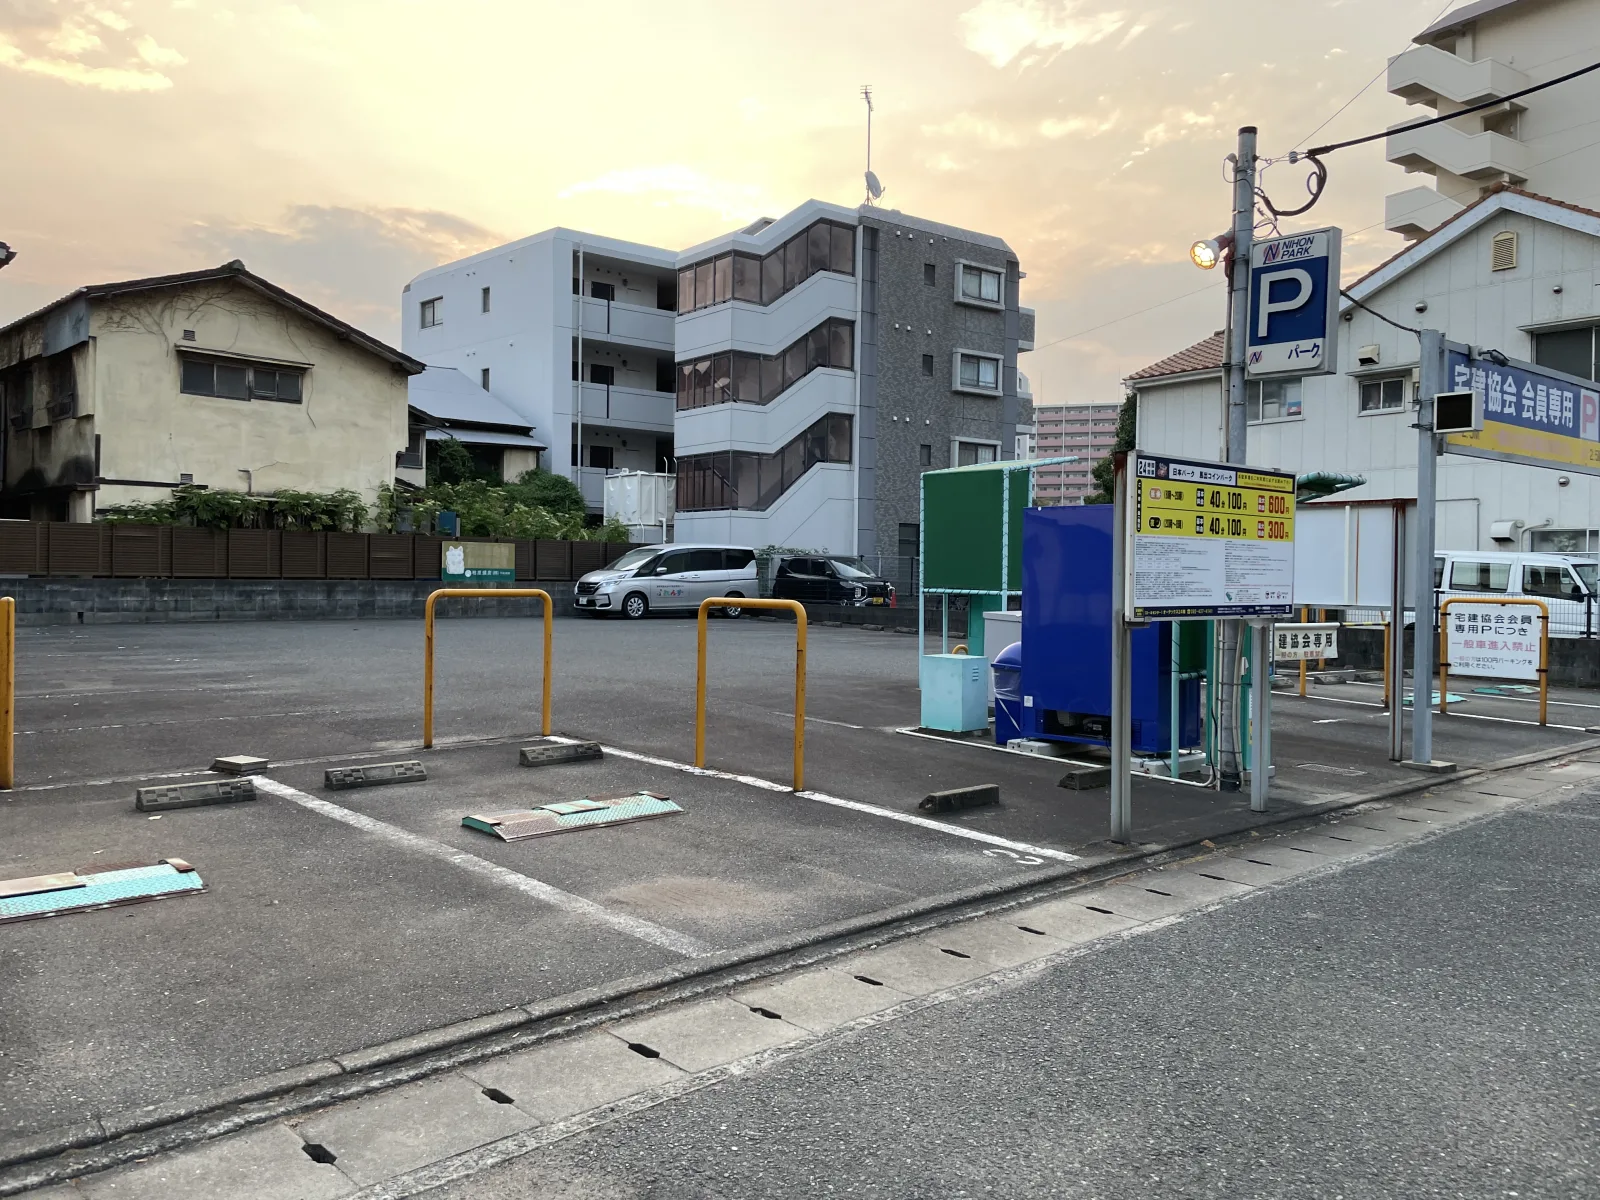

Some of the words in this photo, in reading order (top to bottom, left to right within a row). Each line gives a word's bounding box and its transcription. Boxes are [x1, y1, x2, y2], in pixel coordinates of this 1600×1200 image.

[1282, 236, 1314, 250] NIHON
[1281, 246, 1311, 259] PARK
[1257, 268, 1313, 338] P
[1288, 343, 1320, 359] パーク
[1454, 363, 1517, 416] 宅建協会
[1522, 380, 1573, 429] 会員専用
[1582, 394, 1597, 434] P
[1138, 461, 1146, 475] 24
[1172, 467, 1195, 478] 日本パーク
[1227, 492, 1247, 510] 100円
[1268, 495, 1290, 514] 600円
[1227, 519, 1247, 537] 100円
[1268, 520, 1289, 540] 300円
[1454, 612, 1533, 625] 宅建協会会員
[1454, 624, 1529, 636] 専用Pにつき
[1278, 633, 1333, 649] 建協会専用
[1451, 639, 1537, 652] 一般車進入禁止
[1452, 662, 1496, 670] ご利用ください。
